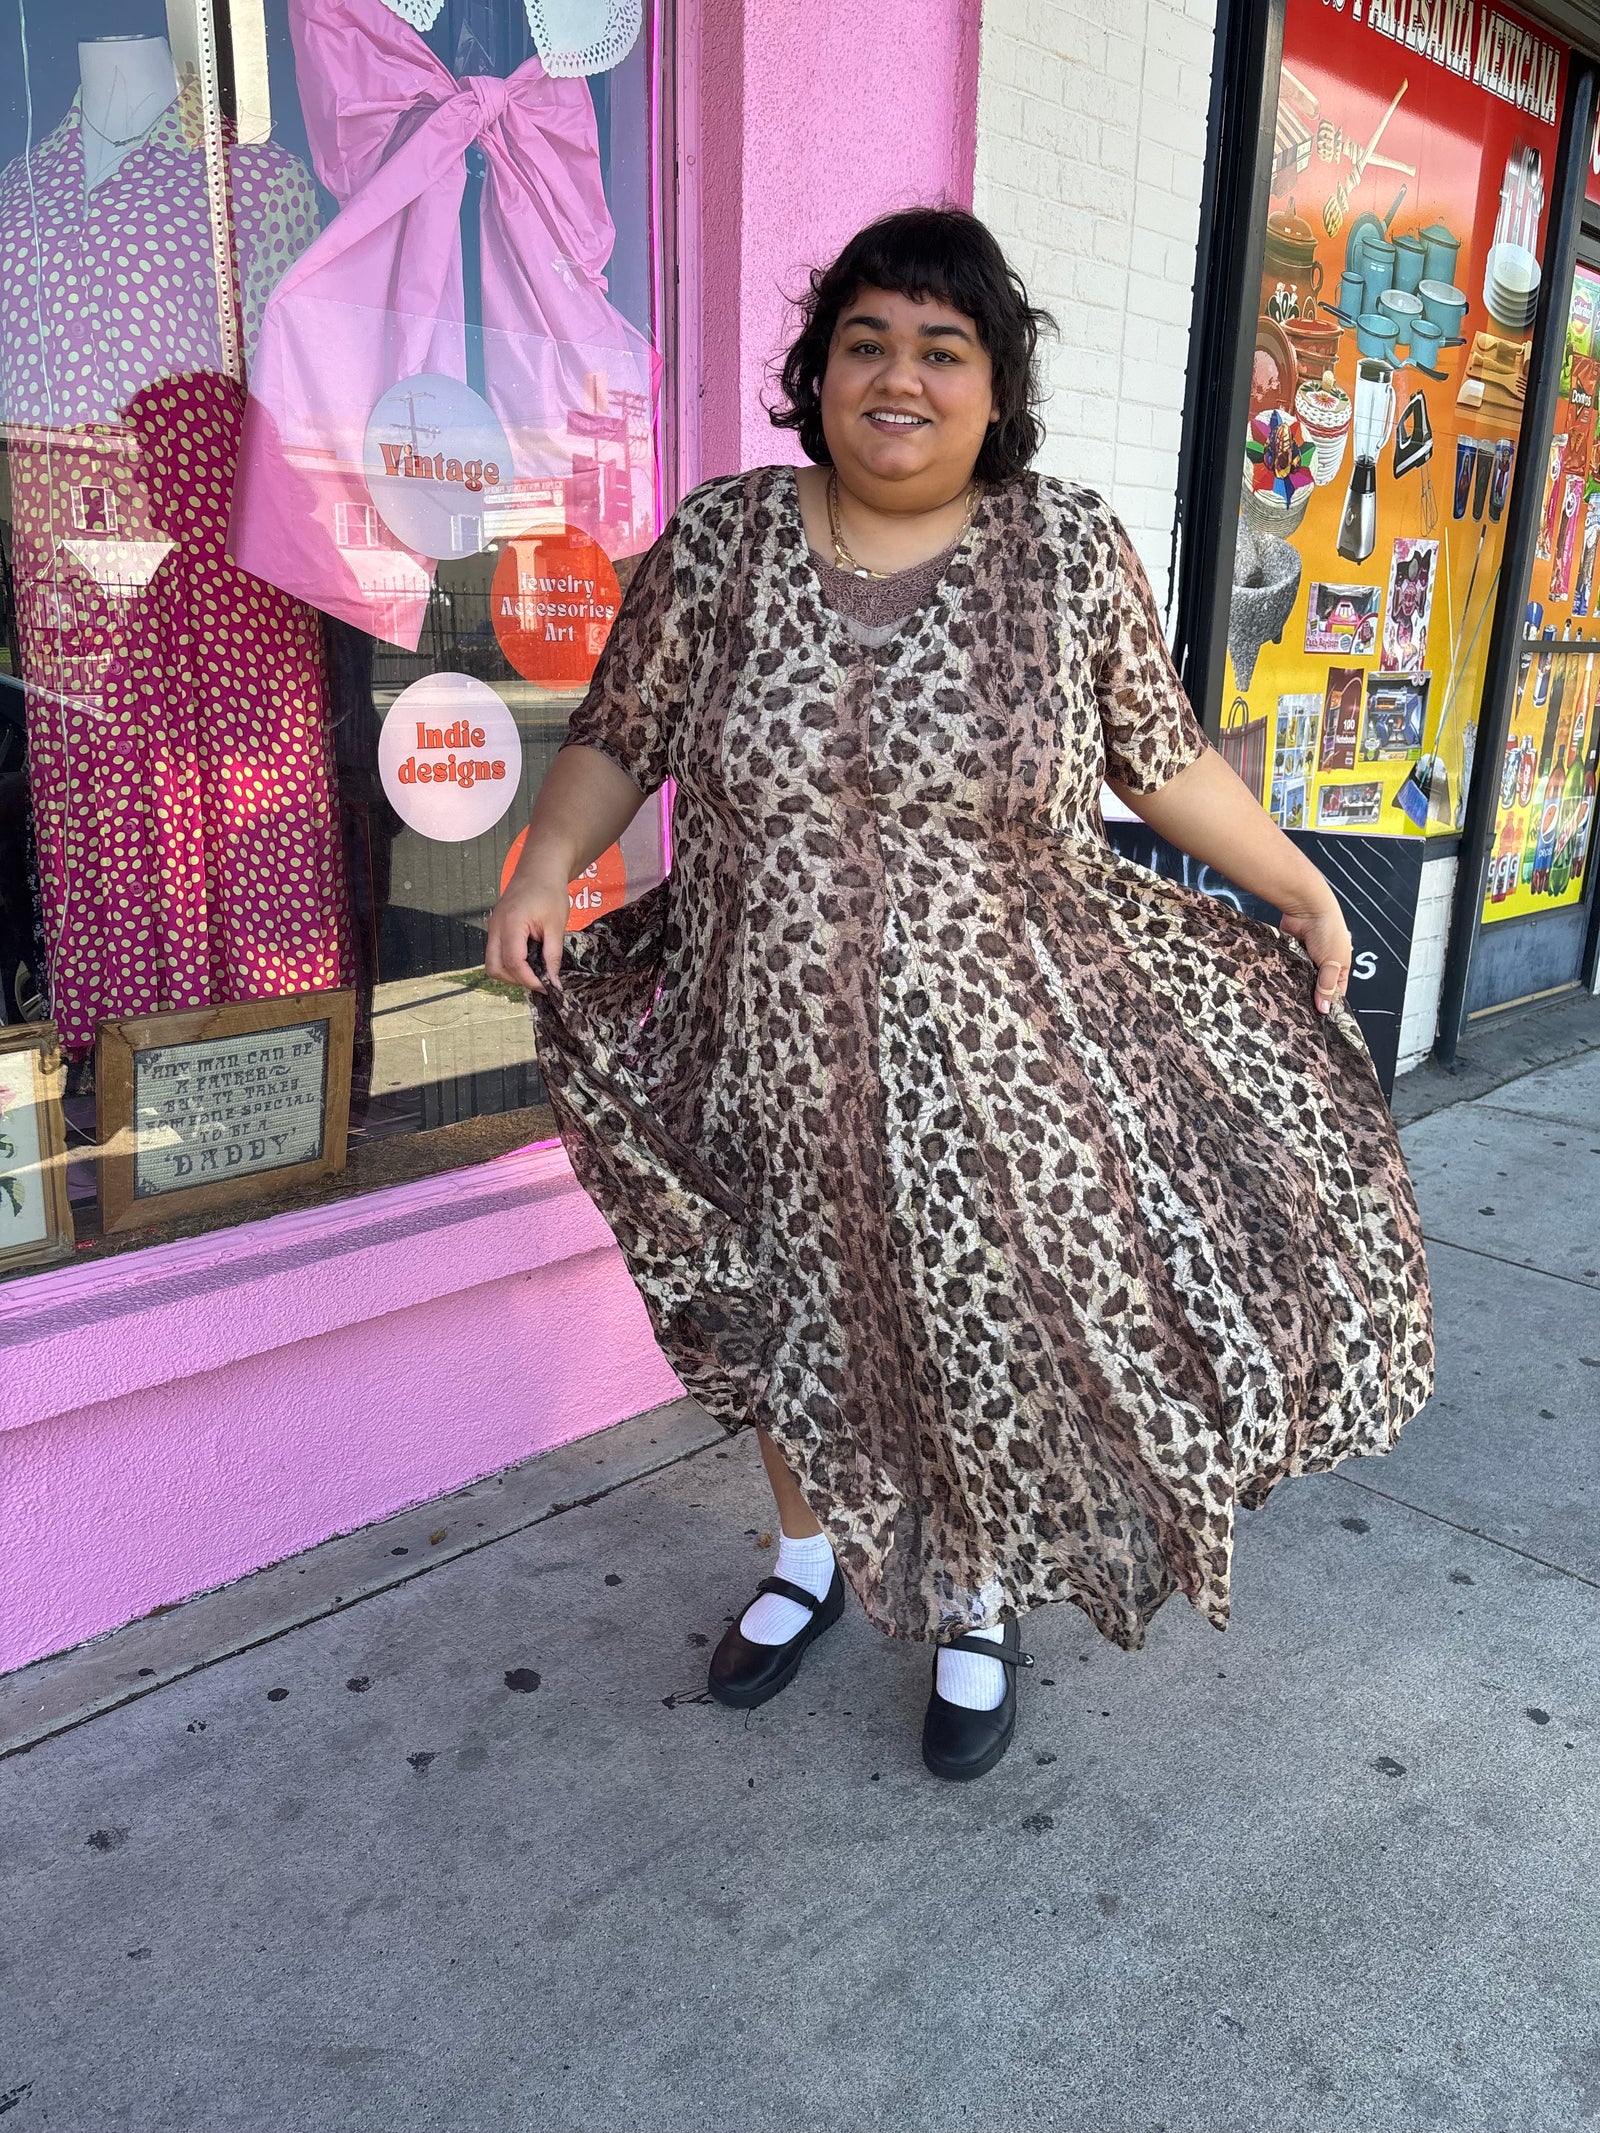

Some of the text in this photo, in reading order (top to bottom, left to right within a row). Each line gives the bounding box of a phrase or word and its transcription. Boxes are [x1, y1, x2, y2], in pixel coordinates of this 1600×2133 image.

[1472, 4, 1561, 126] MEXICANA
[1571, 389, 1592, 407] Doritos
[378, 443, 500, 492] Vintage
[521, 571, 595, 599] Jewelry
[500, 596, 615, 619] Accessories
[544, 622, 575, 642] Art
[415, 719, 486, 749] Indie
[1343, 719, 1356, 730] 100
[397, 754, 506, 788] designs
[568, 886, 603, 910] ds
[197, 1054, 240, 1072] MAN
[247, 1047, 284, 1064] CAN
[292, 1042, 314, 1058] BE
[244, 1078, 299, 1099] TAKES
[241, 1093, 315, 1116] SPECIAL
[200, 1119, 269, 1144] TO BE A
